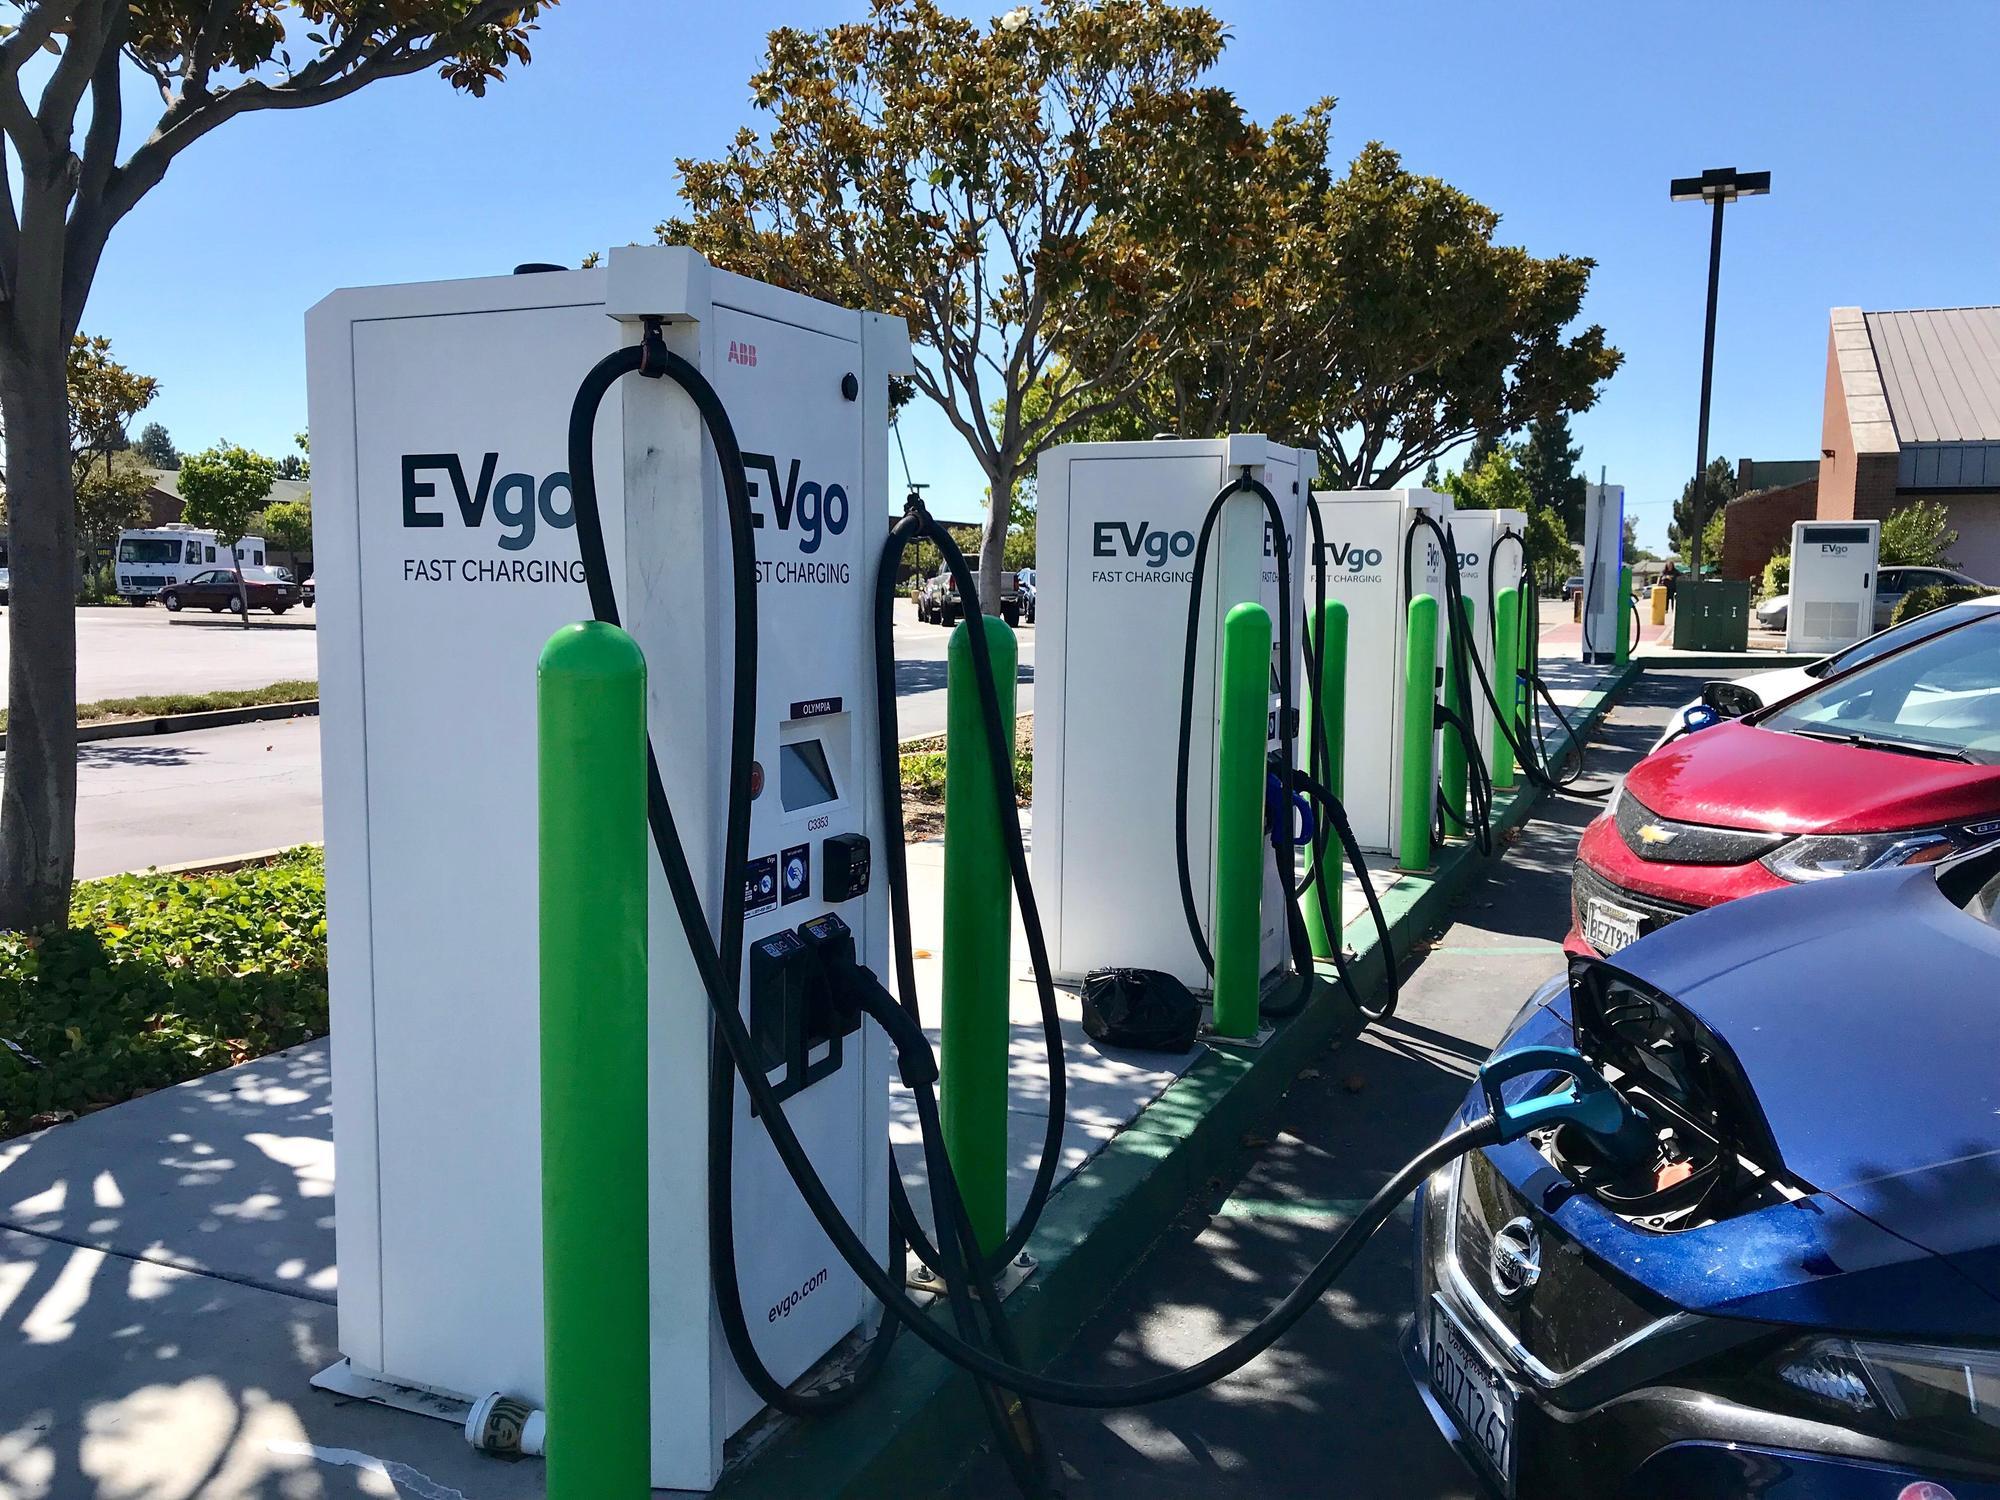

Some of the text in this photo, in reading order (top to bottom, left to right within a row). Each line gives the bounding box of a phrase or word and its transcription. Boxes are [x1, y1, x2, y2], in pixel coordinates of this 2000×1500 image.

[727, 340, 758, 368] ABB
[401, 452, 577, 551] EVgo
[1093, 521, 1195, 568] EVgo
[1821, 544, 1848, 555] EVgo
[1456, 552, 1479, 570] go
[403, 559, 587, 584] FAST CHARGING
[755, 561, 850, 585] ST CHARGING
[1092, 571, 1194, 583] FAST CHARGING
[1310, 574, 1382, 583] FT CHARGING
[1460, 571, 1479, 579] GING
[802, 701, 831, 716] OLYMPIA
[807, 815, 829, 832] C3353
[829, 916, 845, 929] 2
[774, 940, 788, 951] DC
[786, 932, 801, 946] 1
[768, 1267, 827, 1323] evgo.com
[1434, 1340, 1509, 1472] 8DZT267
